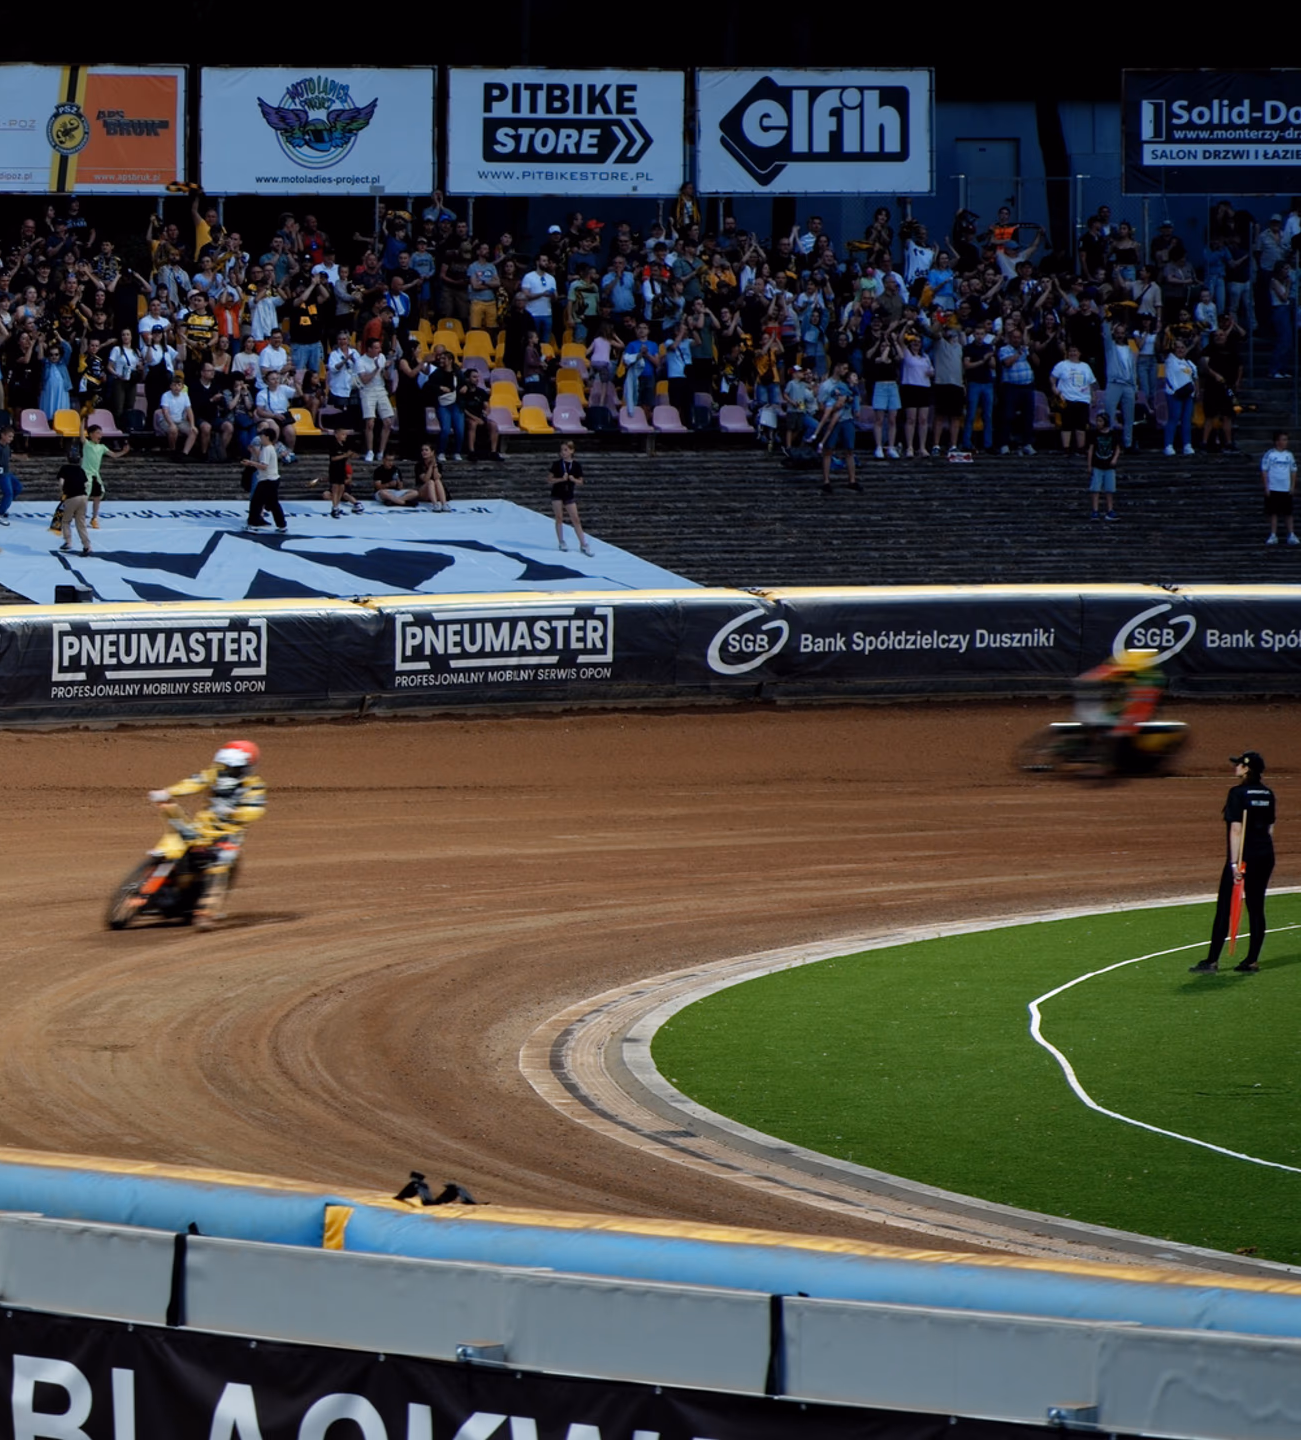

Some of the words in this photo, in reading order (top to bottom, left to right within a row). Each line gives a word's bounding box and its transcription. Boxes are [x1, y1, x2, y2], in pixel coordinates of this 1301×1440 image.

[482, 82, 638, 115] PITBIKE
[741, 87, 902, 153] elfih
[493, 126, 602, 155] STORE
[1173, 128, 1301, 142] www.monterzy-dr
[1150, 149, 1198, 160] SALON
[1202, 149, 1250, 160] DRZWI
[255, 174, 381, 185] www.motoladies-project.pl
[477, 170, 654, 181] WWW.PITBIKESTORE.PL
[404, 619, 605, 657] PNEUMASTER
[727, 632, 769, 654] SGB
[799, 631, 846, 655] Bank
[851, 628, 969, 655] Spółdzielczy
[975, 627, 1056, 649] Duszniki
[1132, 627, 1176, 647] SGB
[1205, 629, 1256, 648] Bank
[62, 630, 259, 667] PNEUMASTER
[394, 671, 485, 688] PROFESJONALNY
[487, 670, 535, 683] MOBILNY
[537, 668, 577, 681] SERWIS
[579, 667, 612, 680] OPON
[50, 683, 141, 699] PROFESJONALNY
[142, 682, 190, 696] MOBILNY
[191, 681, 232, 694] SERWIS
[233, 680, 266, 693] OPON
